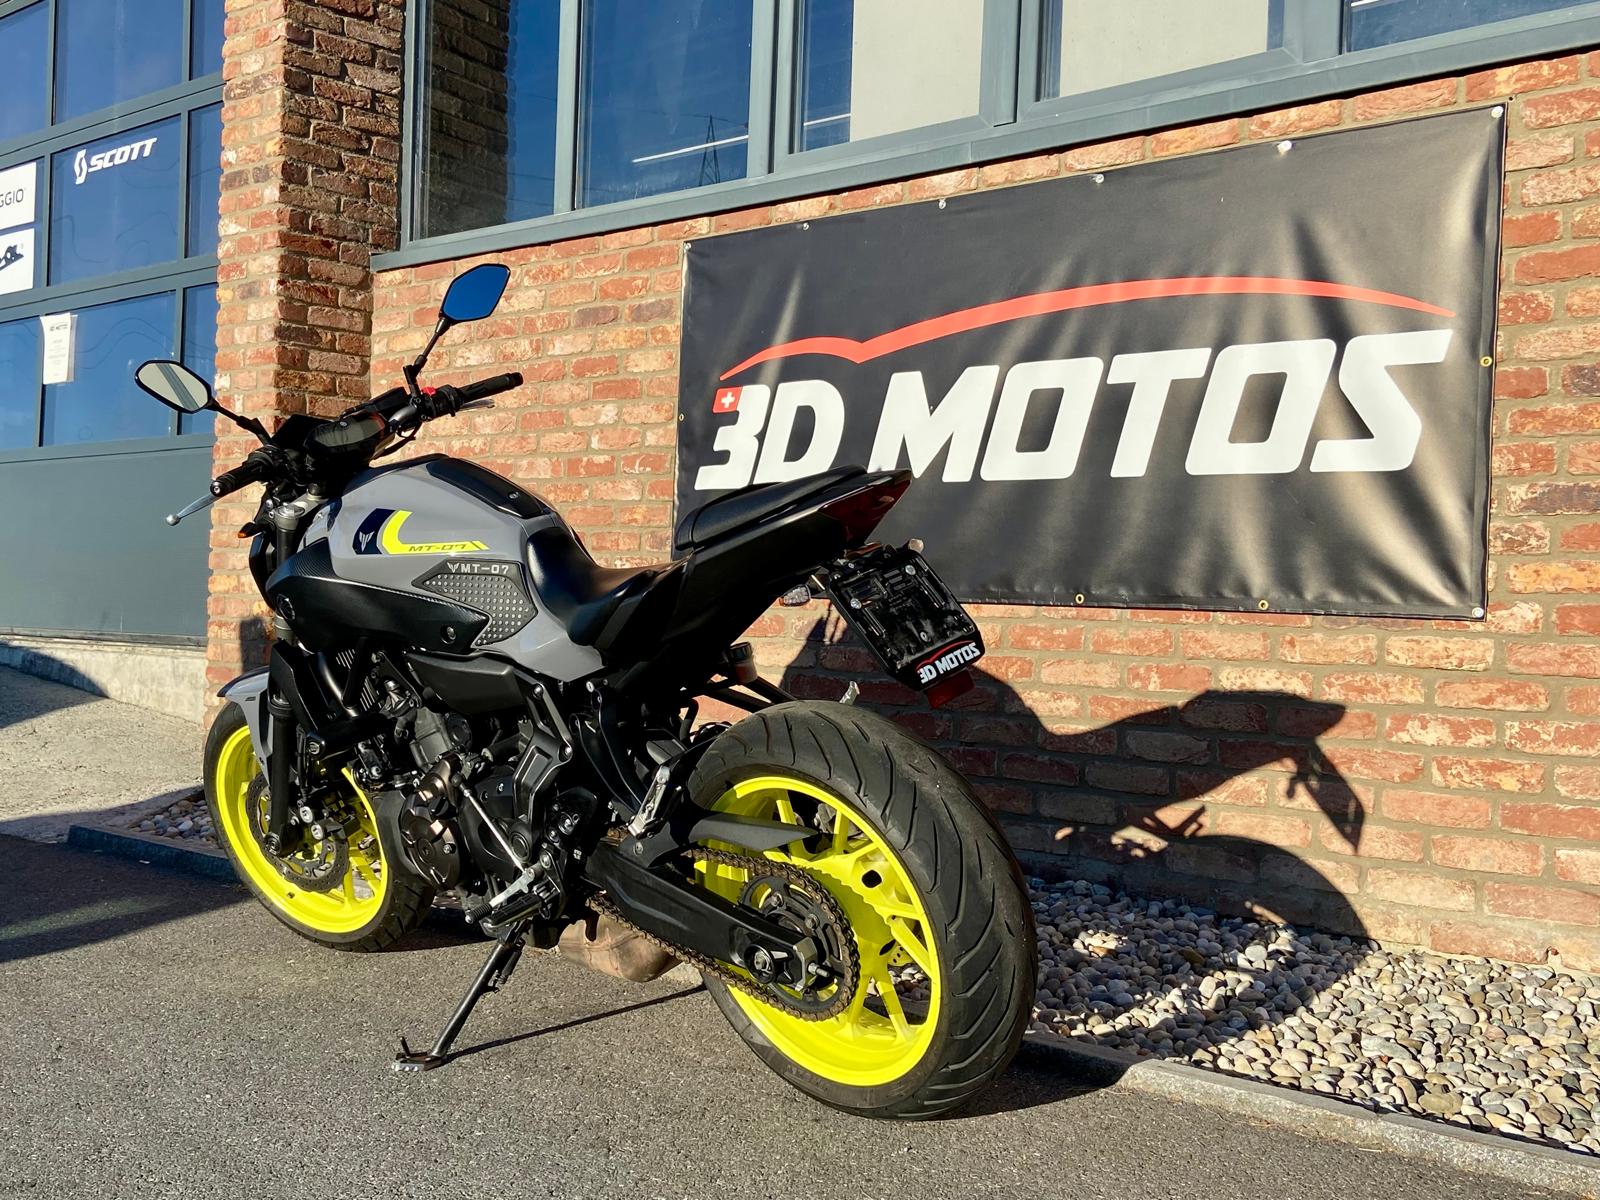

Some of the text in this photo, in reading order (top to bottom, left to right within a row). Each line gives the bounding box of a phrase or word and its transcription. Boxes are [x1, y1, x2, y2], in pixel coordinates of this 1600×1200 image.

[88, 138, 157, 172] SCOTT
[694, 329, 1453, 490] 3D MOTOS
[409, 544, 467, 552] MT-07
[461, 564, 509, 574] MT-07
[917, 642, 981, 684] 3D MOTOS
